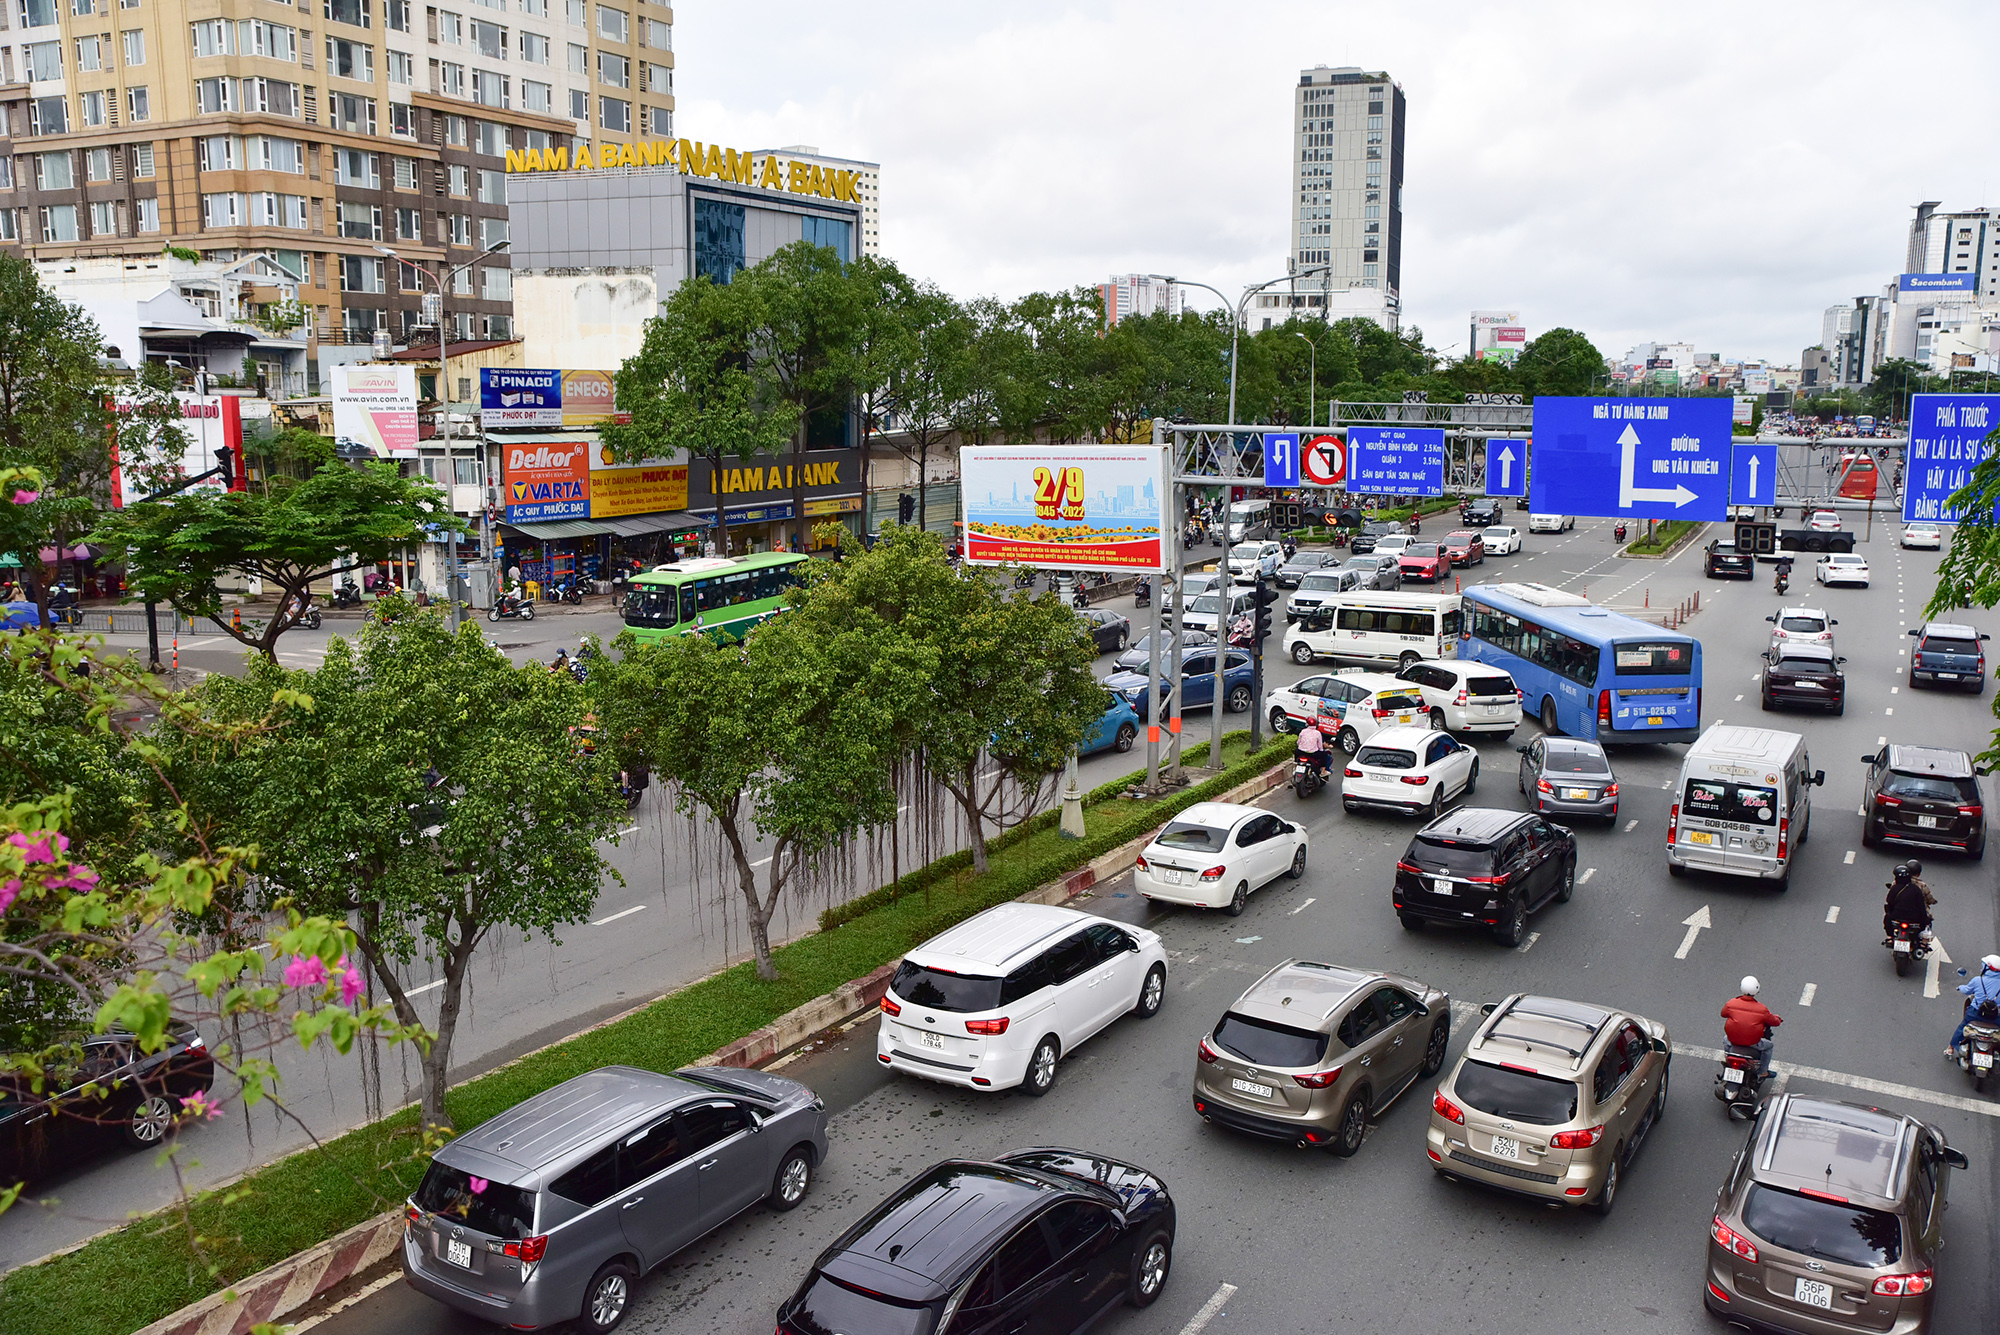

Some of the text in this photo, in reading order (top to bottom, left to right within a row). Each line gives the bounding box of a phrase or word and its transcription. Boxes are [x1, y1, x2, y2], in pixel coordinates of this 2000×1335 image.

[506, 140, 678, 173] NAM A BANK
[679, 138, 861, 203] NAM A BANK
[1910, 277, 1963, 287] Sacombank
[501, 376, 553, 387] PINACO
[565, 381, 609, 397] ENEOS
[339, 395, 410, 403] www.avin.com.vn
[1593, 402, 1669, 420] NGÃ TƯ HÀNG XANH
[1936, 402, 1989, 428] PHÍA TRƯỚC
[1380, 430, 1391, 439] NÚT
[1401, 442, 1418, 452] KHIÊM
[1424, 444, 1442, 453] 2.5 Km
[1671, 433, 1700, 452] ĐƯỜNG
[1915, 434, 1980, 463] TAY LÁI LÀ SỰ
[509, 447, 575, 470] Delkor
[1398, 455, 1402, 464] 3
[1423, 457, 1441, 466] 3.5 Km
[1652, 457, 1719, 475] UNG VĂN KHIÊM
[592, 478, 602, 488] ĐẠI
[642, 467, 670, 483] PHƯỚC
[672, 469, 687, 483] ĐẠT
[711, 466, 764, 494] NAM
[767, 465, 783, 490] A
[1362, 469, 1373, 478] SÂN
[1375, 471, 1385, 479] BAY
[1386, 470, 1397, 480] TÂN
[1399, 471, 1410, 480] SƠN
[1926, 465, 1965, 490] HÃY LÁI
[529, 481, 583, 500] VARTA
[1033, 466, 1085, 502] 2/9
[1426, 486, 1431, 494] 7
[513, 504, 524, 517] ẮC
[525, 507, 540, 516] QUY
[543, 501, 569, 514] PHƯỚC
[571, 502, 585, 514] ĐẠT
[1035, 505, 1085, 518] 1945 2022
[1914, 491, 1938, 519] BẰNG
[730, 512, 747, 520] banking
[1668, 649, 1680, 660] 30
[1633, 705, 1677, 717] 51B-025.65
[1318, 716, 1338, 727] ENEOS
[1497, 1136, 1515, 1149] 52U
[1493, 1144, 1516, 1158] 6276
[453, 1241, 466, 1254] 51H
[1803, 1280, 1825, 1295] 56P
[1799, 1291, 1828, 1307] 0106
